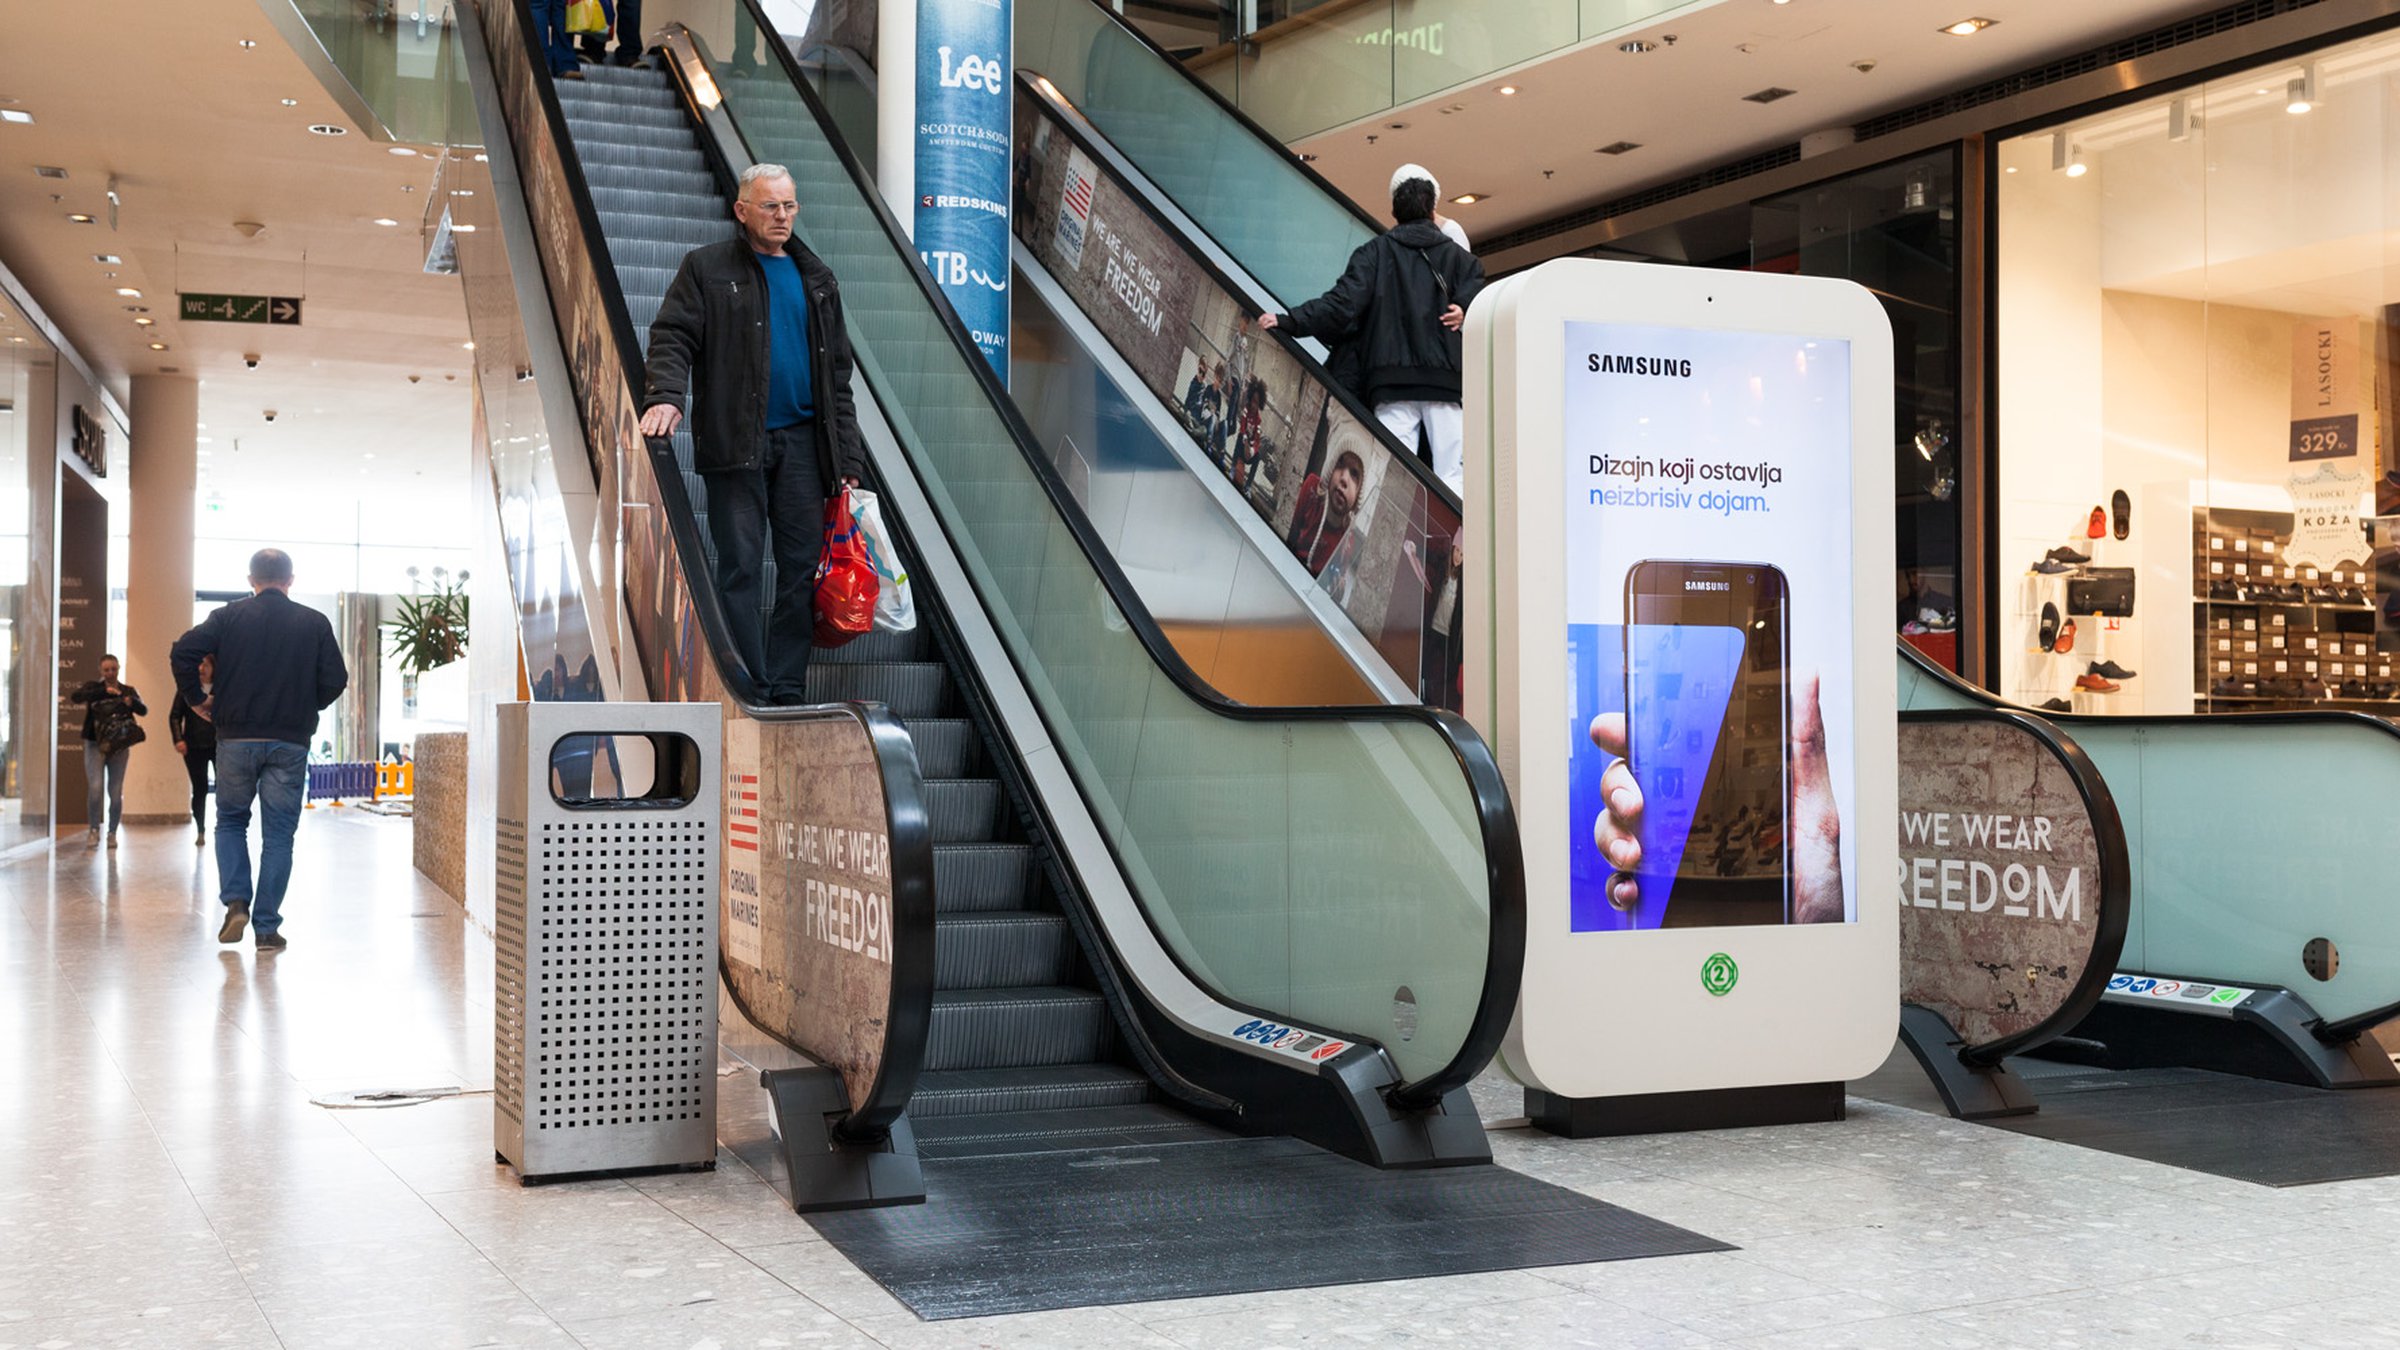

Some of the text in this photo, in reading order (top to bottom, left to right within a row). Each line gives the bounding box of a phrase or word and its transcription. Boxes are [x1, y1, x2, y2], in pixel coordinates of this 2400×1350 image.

[937, 46, 1002, 95] Lee
[920, 123, 1009, 147] SCOTCH&SODA
[936, 195, 1008, 218] REDSKINS
[1093, 213, 1106, 240] WE
[1123, 246, 1138, 274] WE
[1138, 261, 1161, 299] WEAR
[185, 300, 207, 314] WC
[1104, 256, 1163, 337] FREEDOM
[1588, 353, 1692, 378] SAMSUNG
[2317, 329, 2332, 407] LASOCKI
[2299, 431, 2338, 453] 329
[1590, 454, 1782, 488] Dizajn koji ostavlja
[1590, 485, 1770, 517] neizbrisiv dojam.
[2303, 514, 2351, 527] KOŽA
[1685, 581, 1730, 591] SAMSUNG
[1902, 811, 2053, 852] WE WEAR
[775, 820, 795, 860] WE
[824, 828, 845, 870] WE
[848, 830, 889, 878] WEAR
[730, 868, 759, 898] ORIGINAL
[730, 898, 760, 929] MARINES
[1713, 965, 1725, 982] 2
